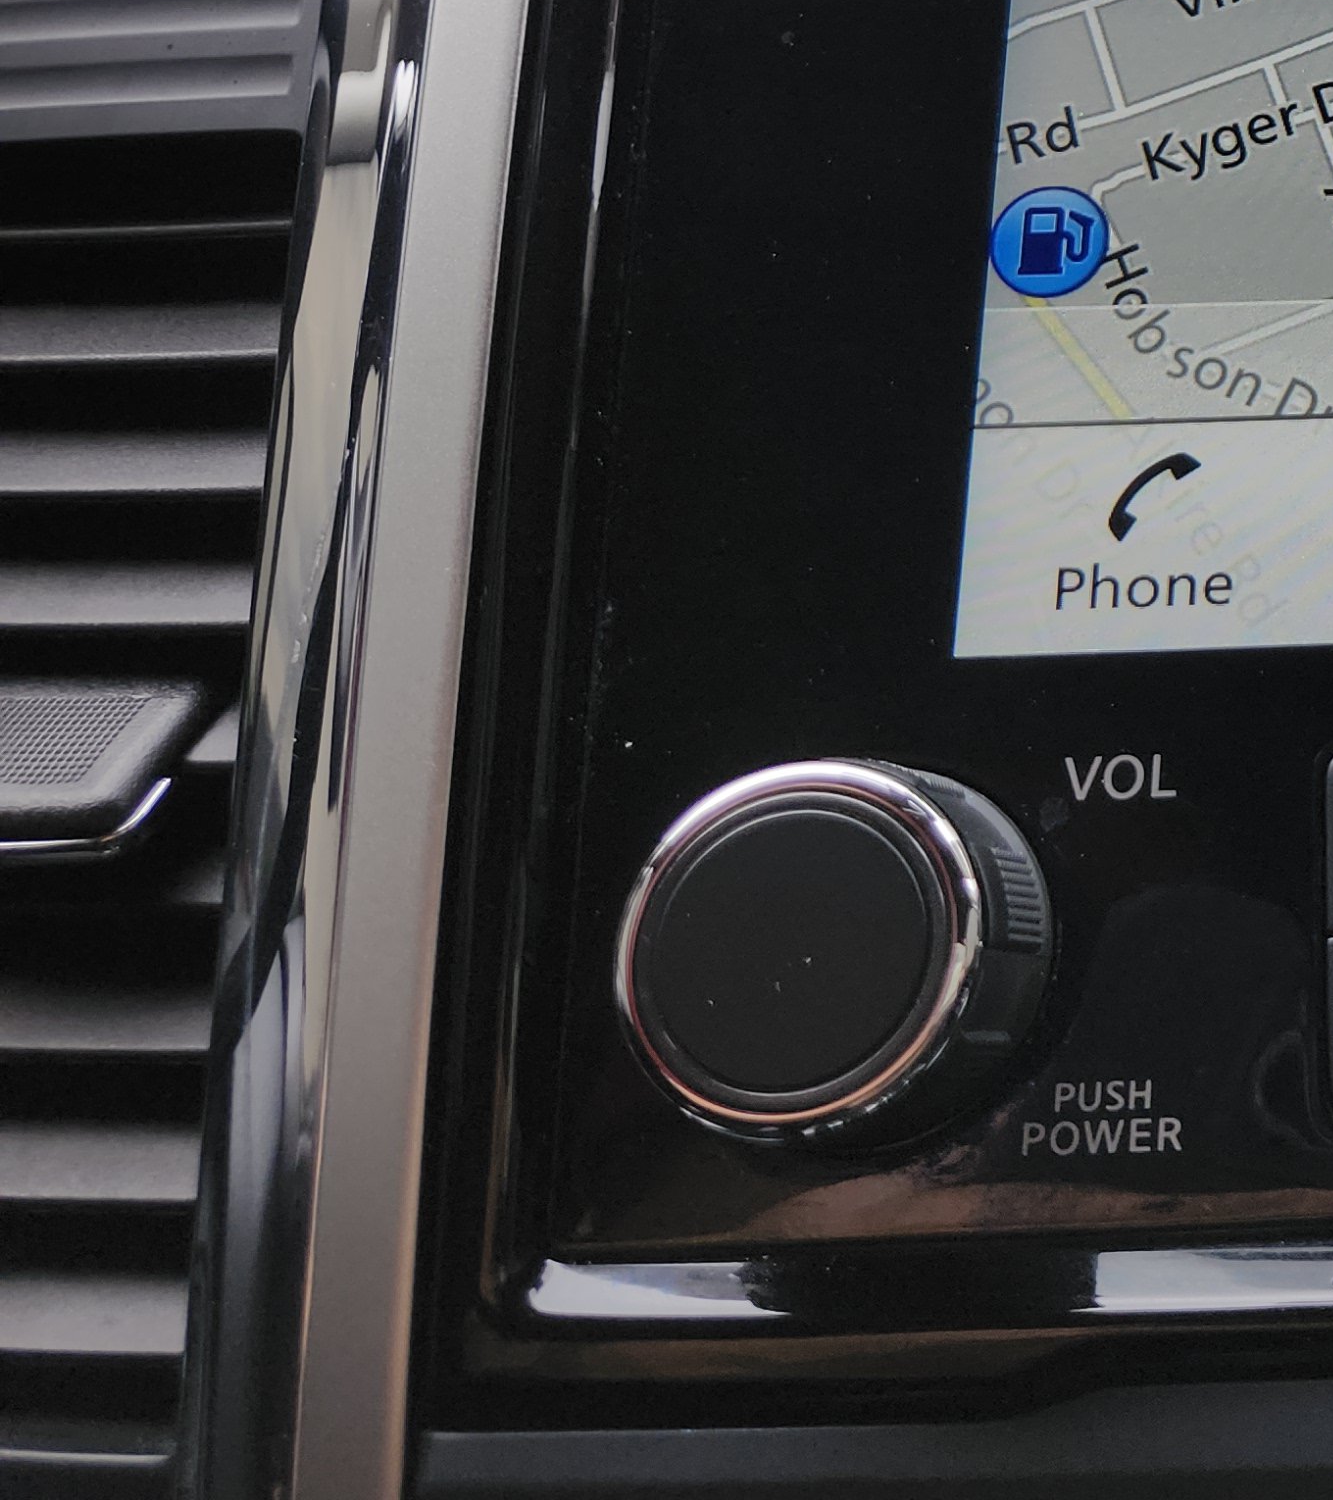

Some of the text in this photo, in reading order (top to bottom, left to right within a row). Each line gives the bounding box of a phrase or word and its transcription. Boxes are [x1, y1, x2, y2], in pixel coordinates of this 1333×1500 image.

[1006, 106, 1081, 164] Rd
[1140, 104, 1299, 182] Kyger
[1101, 243, 1262, 407] Hobson
[1055, 562, 1234, 611] Phone
[1064, 754, 1177, 802] VOL
[1054, 1079, 1152, 1113] PUSH
[1021, 1116, 1183, 1156] POWER
